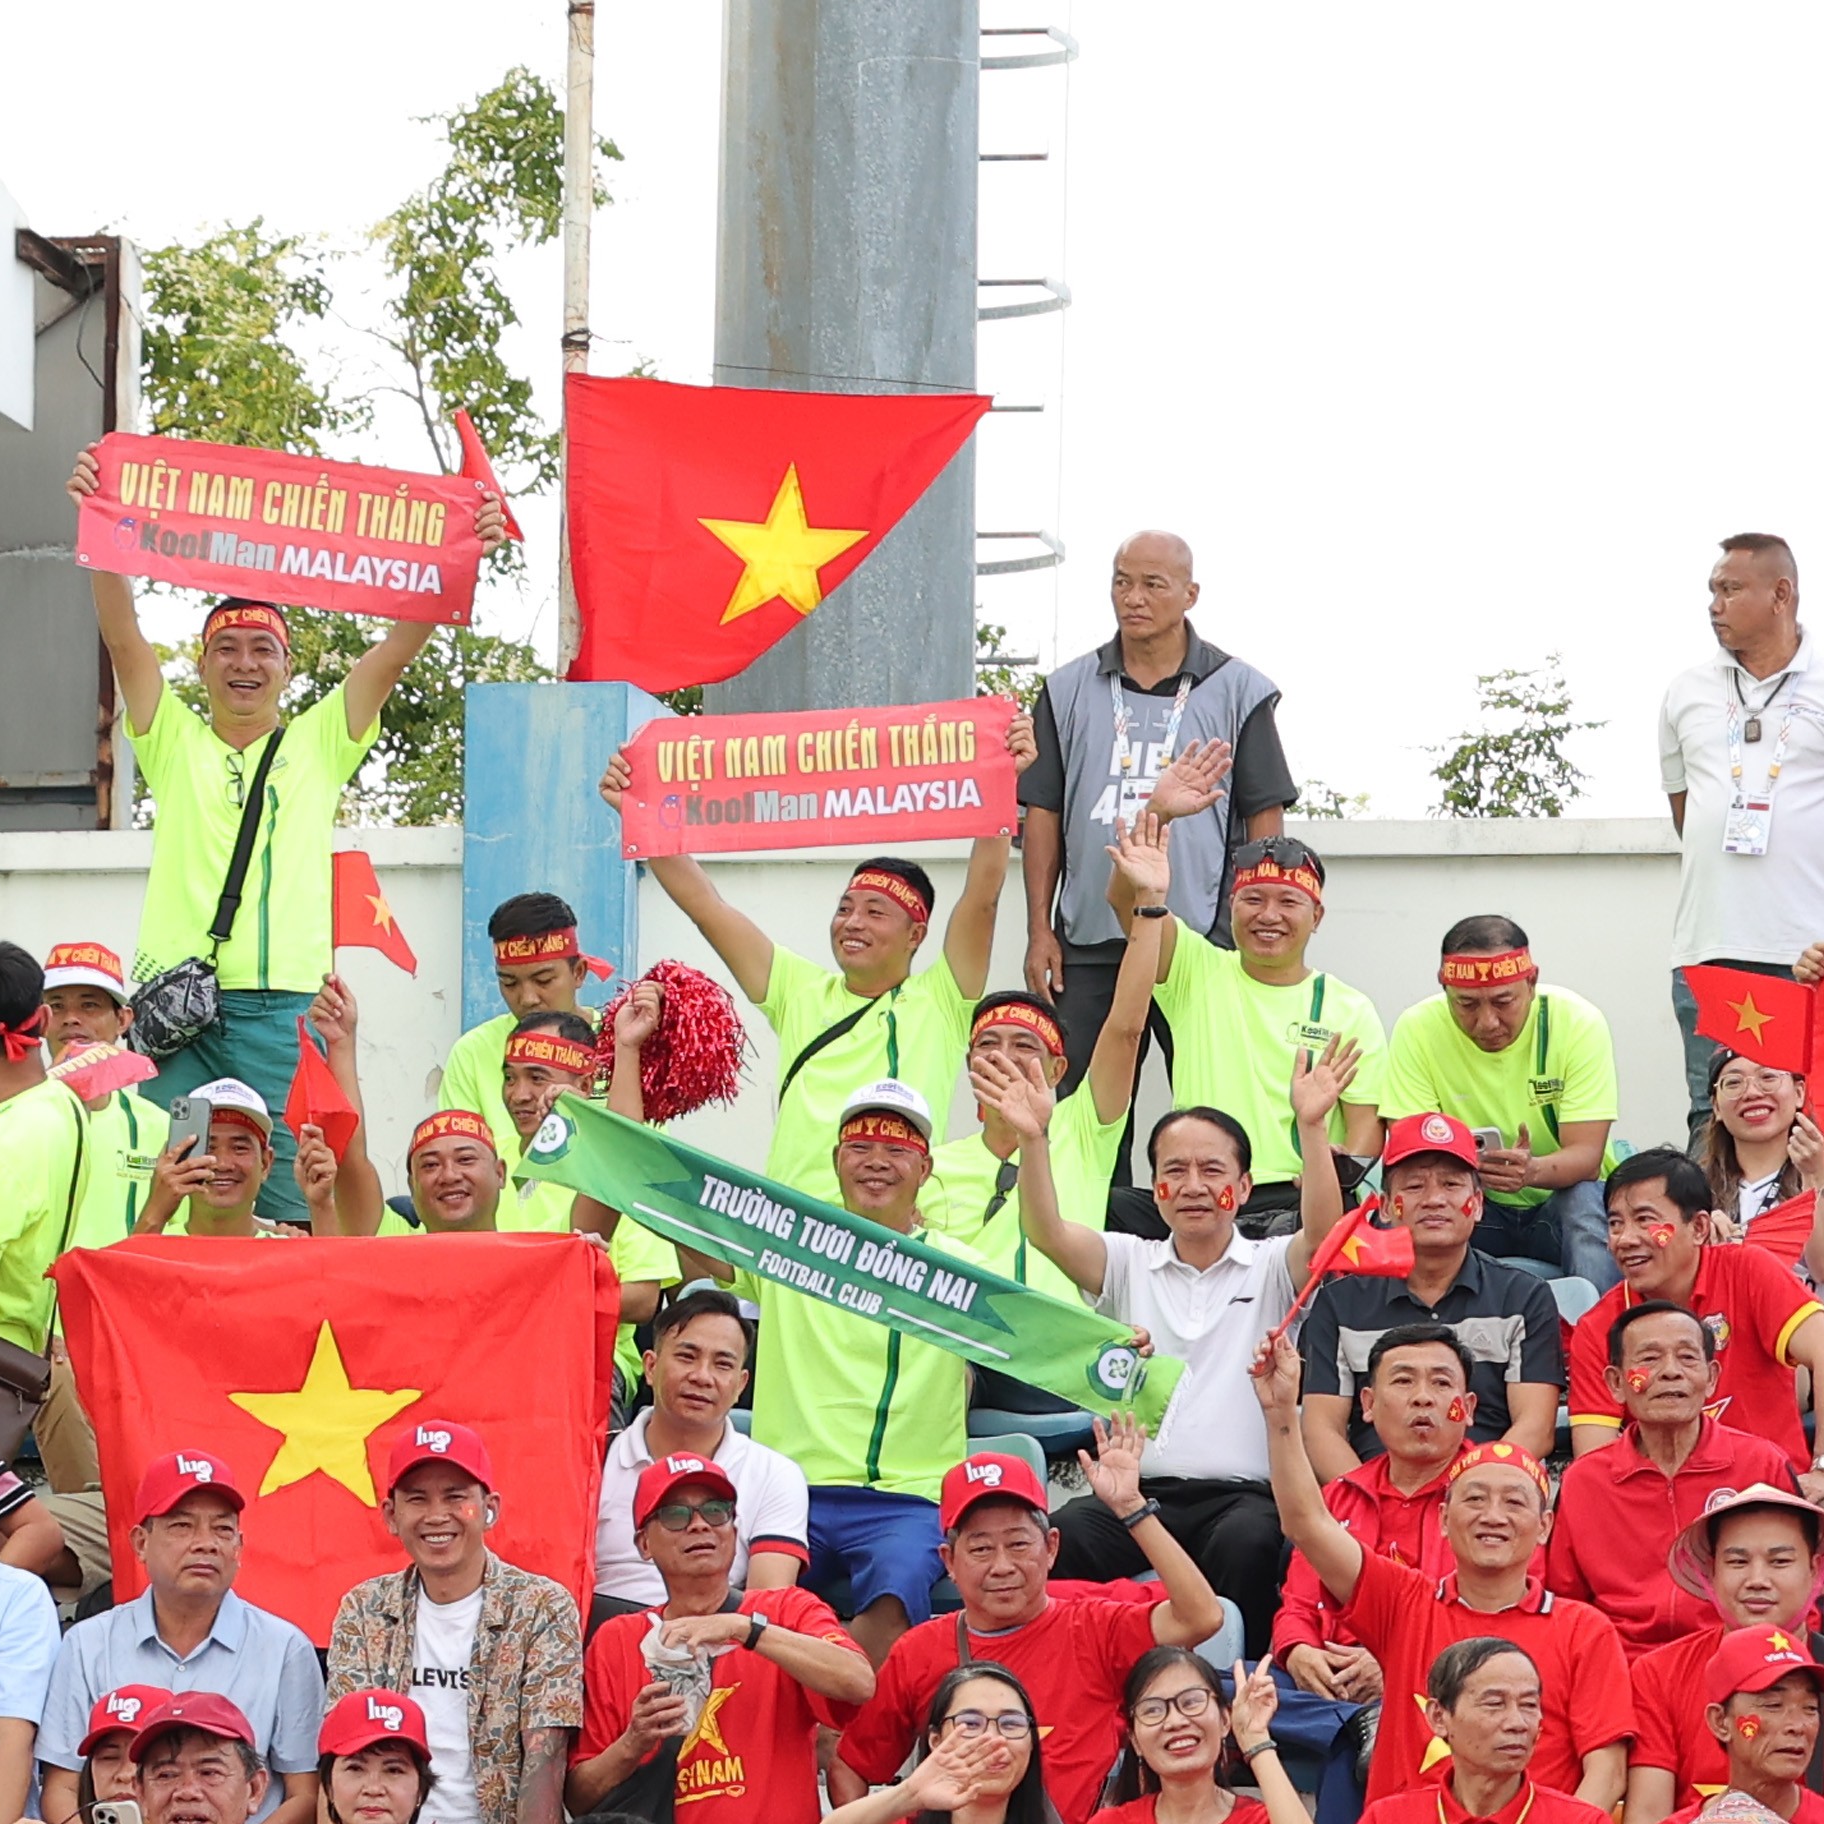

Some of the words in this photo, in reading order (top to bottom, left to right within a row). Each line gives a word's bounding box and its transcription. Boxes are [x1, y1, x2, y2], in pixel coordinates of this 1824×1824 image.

[120, 459, 181, 521] VIỆT
[189, 476, 255, 521] NAM
[262, 474, 348, 533] CHIẾN
[358, 484, 447, 548] THẮNG
[138, 522, 276, 572] KoolMan
[281, 545, 442, 595] MALAYSIA
[657, 735, 716, 791] VIỆT
[724, 733, 787, 779] NAM
[798, 718, 879, 772] CHIẾN
[888, 714, 975, 766] THẮNG
[685, 789, 818, 826] KoolMan
[823, 778, 981, 819] MALAYSIA
[699, 1174, 797, 1240] TRƯỜNG
[801, 1214, 853, 1264] TƯƠI
[856, 1240, 929, 1296] ĐỒNG
[928, 1272, 979, 1314] NAI
[757, 1249, 836, 1299] FOOTBALL
[836, 1282, 884, 1315] CLUB
[416, 1426, 451, 1453] lug
[175, 1454, 213, 1483] lug
[964, 1462, 1003, 1487] lug
[412, 1666, 470, 1690] LEVI'S
[106, 1692, 142, 1722] lug
[367, 1696, 403, 1731] lug
